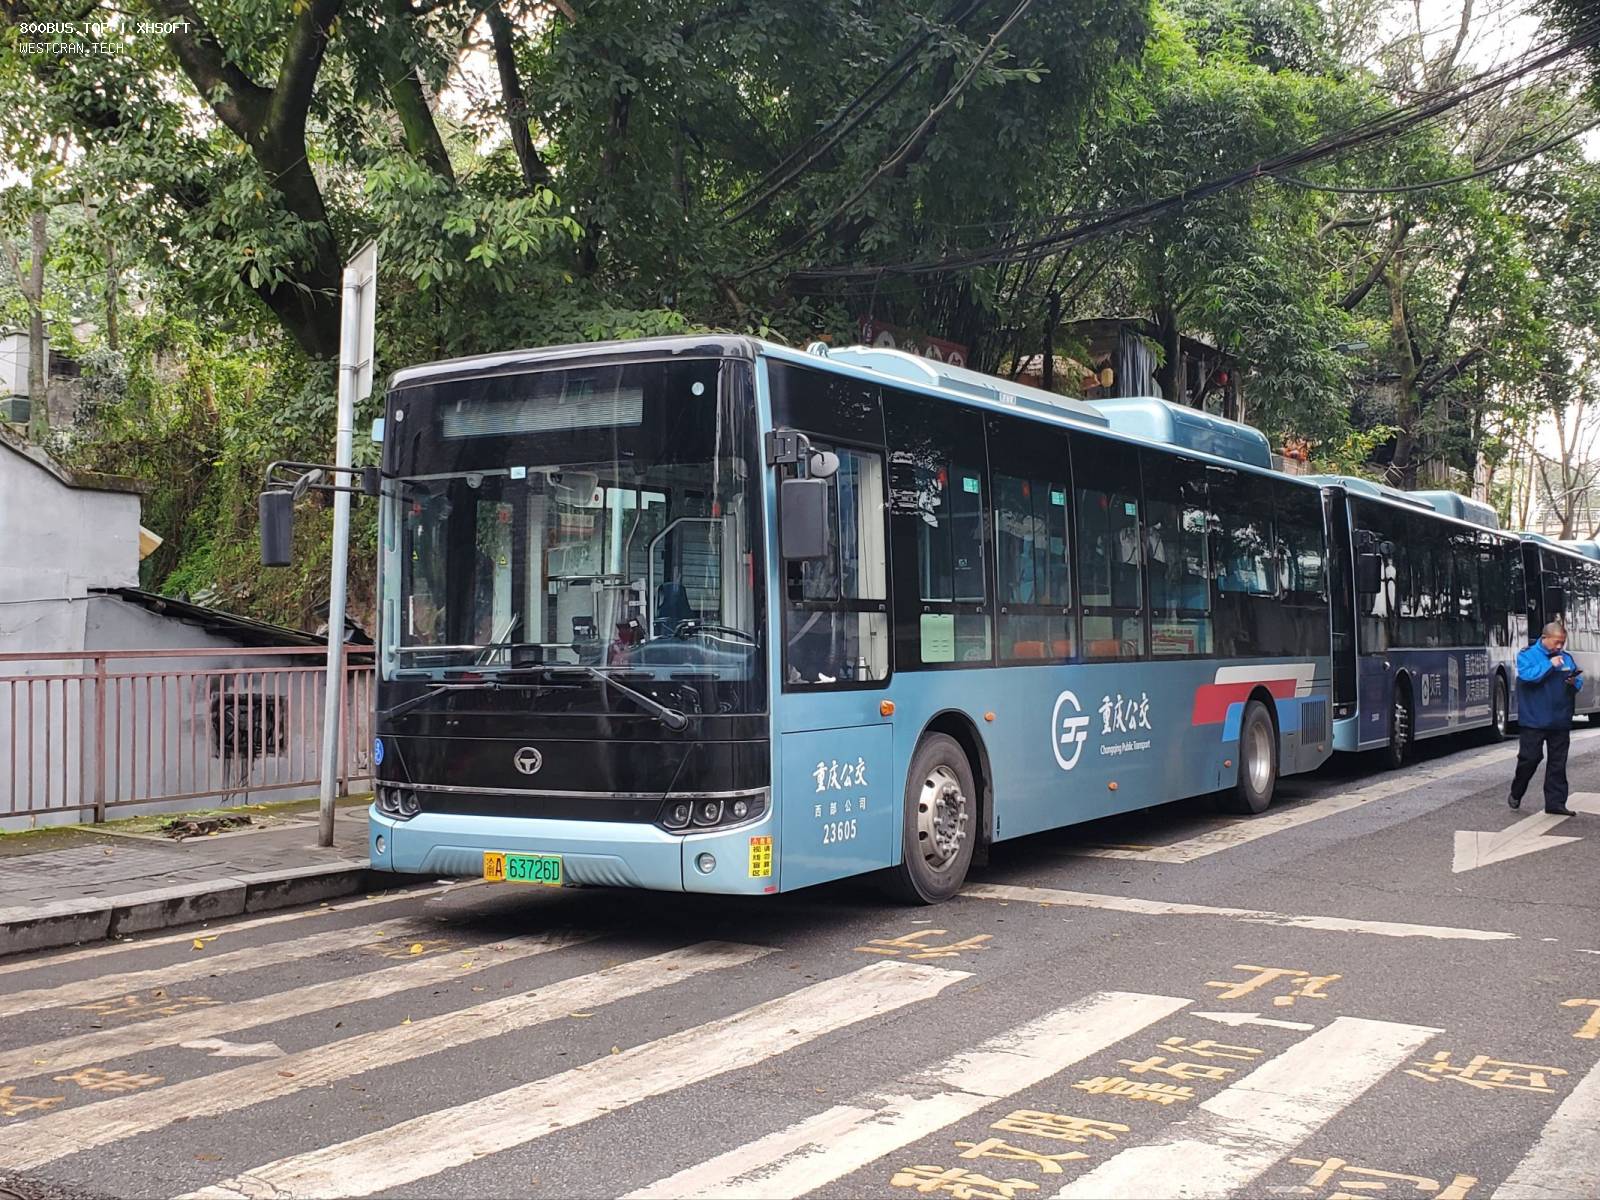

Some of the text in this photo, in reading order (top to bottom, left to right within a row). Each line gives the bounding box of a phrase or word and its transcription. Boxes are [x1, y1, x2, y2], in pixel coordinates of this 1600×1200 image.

[1098, 692, 1152, 735] 重庆公交
[813, 757, 868, 793] 重庆公交
[814, 797, 866, 817] 西部公司
[823, 818, 857, 844] 23605
